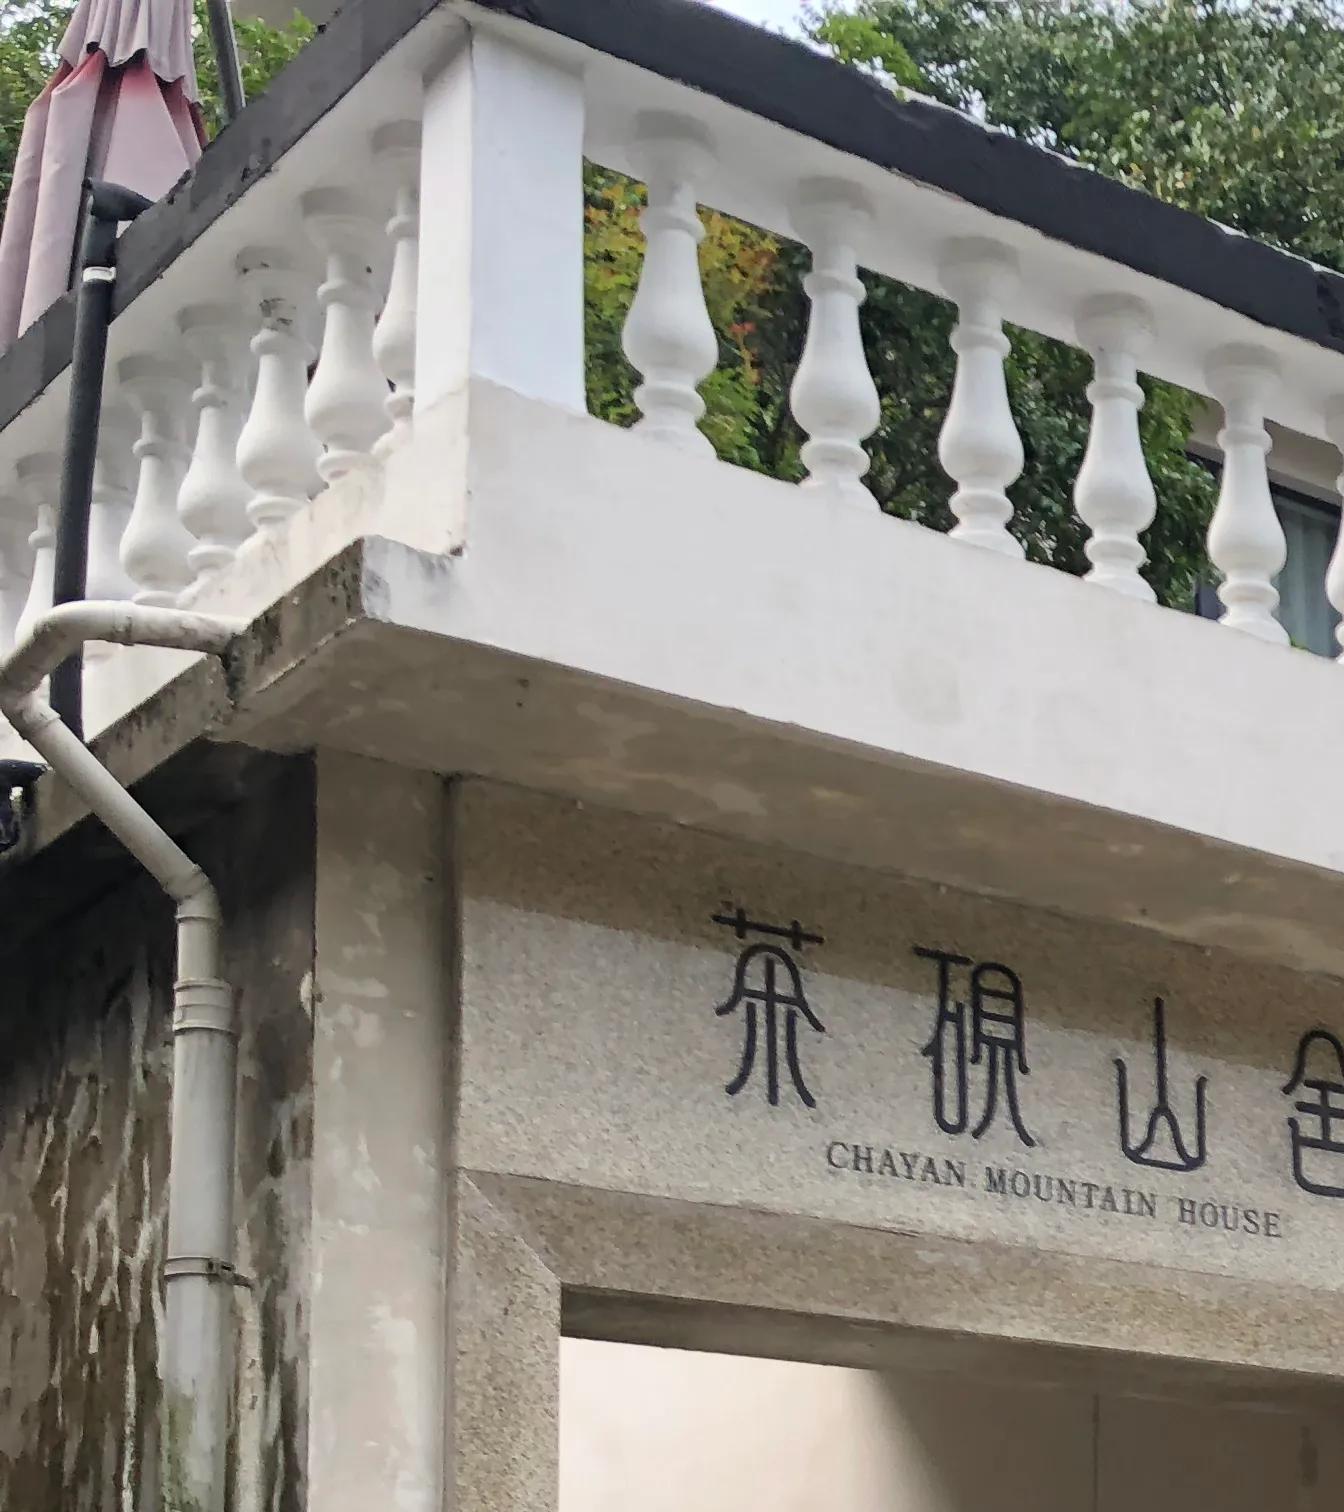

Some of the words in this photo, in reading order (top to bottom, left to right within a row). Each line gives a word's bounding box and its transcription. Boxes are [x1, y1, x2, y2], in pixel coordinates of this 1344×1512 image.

[826, 1141, 967, 1188] CHAYAN
[984, 1165, 1157, 1218] MOUNTAIN
[1178, 1197, 1283, 1238] HOUSE
